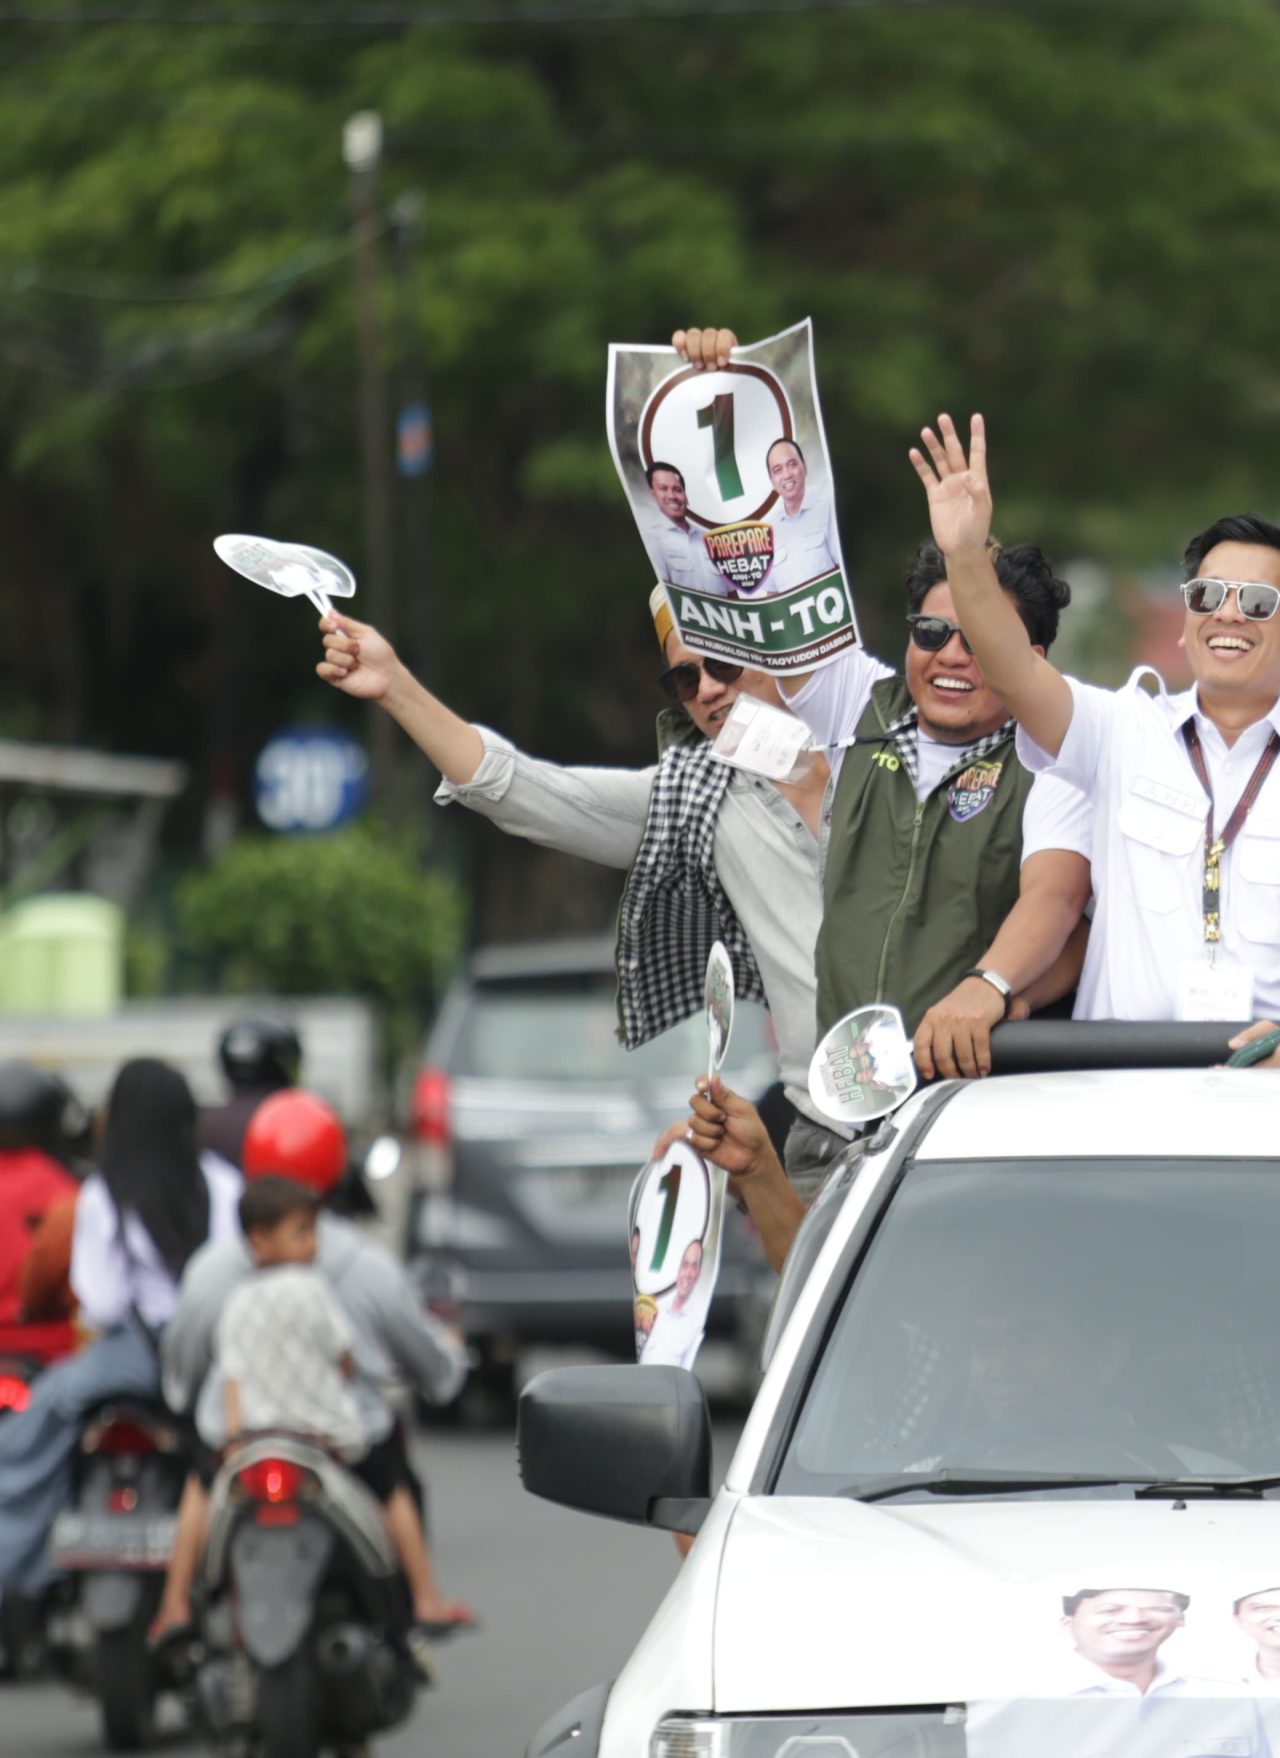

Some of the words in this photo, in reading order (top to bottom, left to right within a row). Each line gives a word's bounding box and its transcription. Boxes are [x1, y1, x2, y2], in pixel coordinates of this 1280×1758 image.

[696, 393, 746, 502] 1
[706, 527, 773, 559] PAREPARE
[717, 555, 770, 574] HEBAT
[826, 1045, 864, 1104] HEBAT
[649, 1164, 682, 1272] 1
